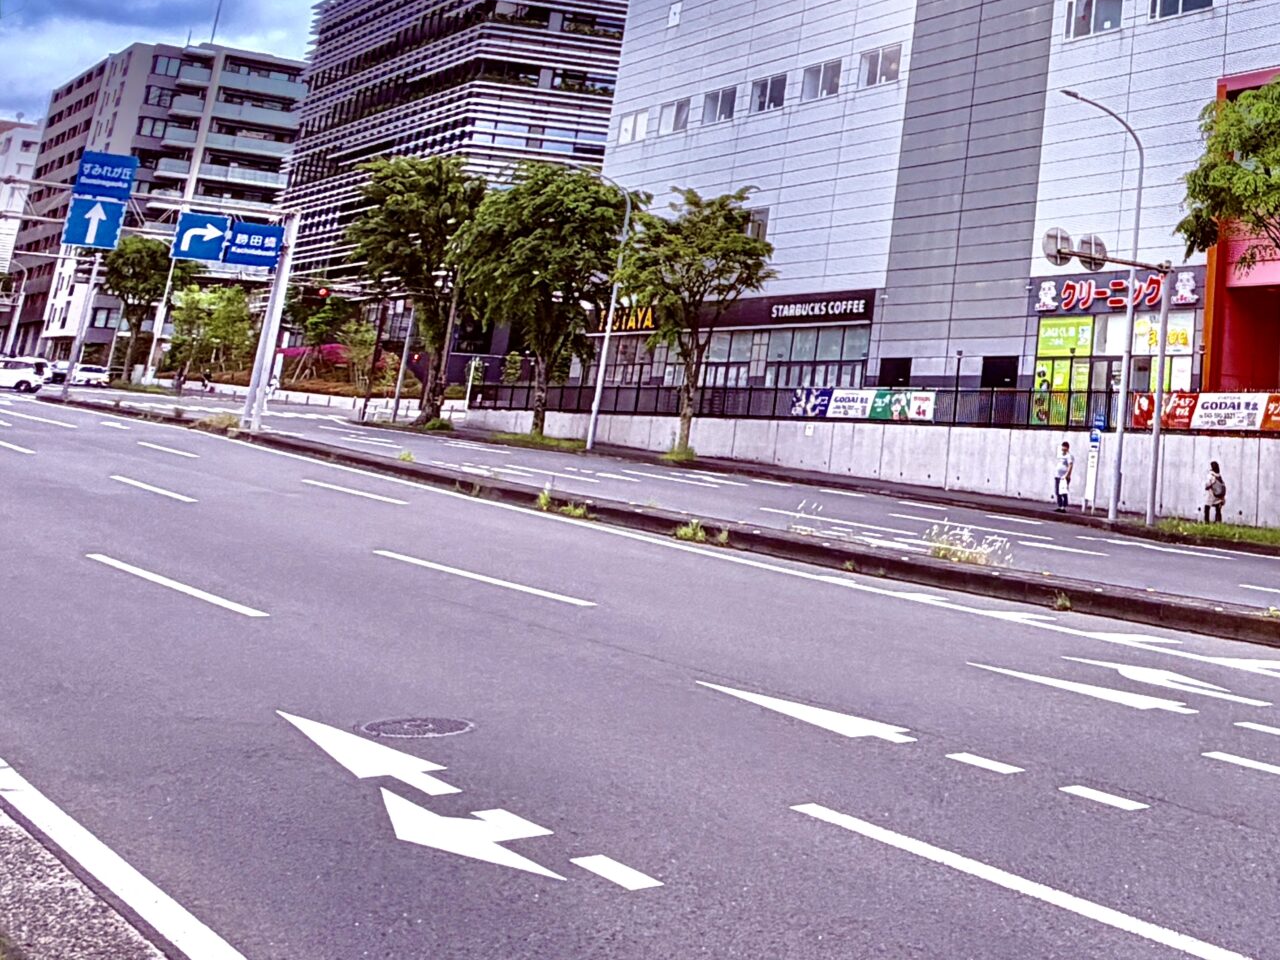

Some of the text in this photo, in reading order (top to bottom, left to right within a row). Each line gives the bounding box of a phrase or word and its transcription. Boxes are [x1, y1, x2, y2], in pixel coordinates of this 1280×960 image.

[82, 163, 133, 179] すみれが丘
[771, 300, 865, 318] STARBUCKS COFFEE
[1201, 401, 1241, 410] GODAI
